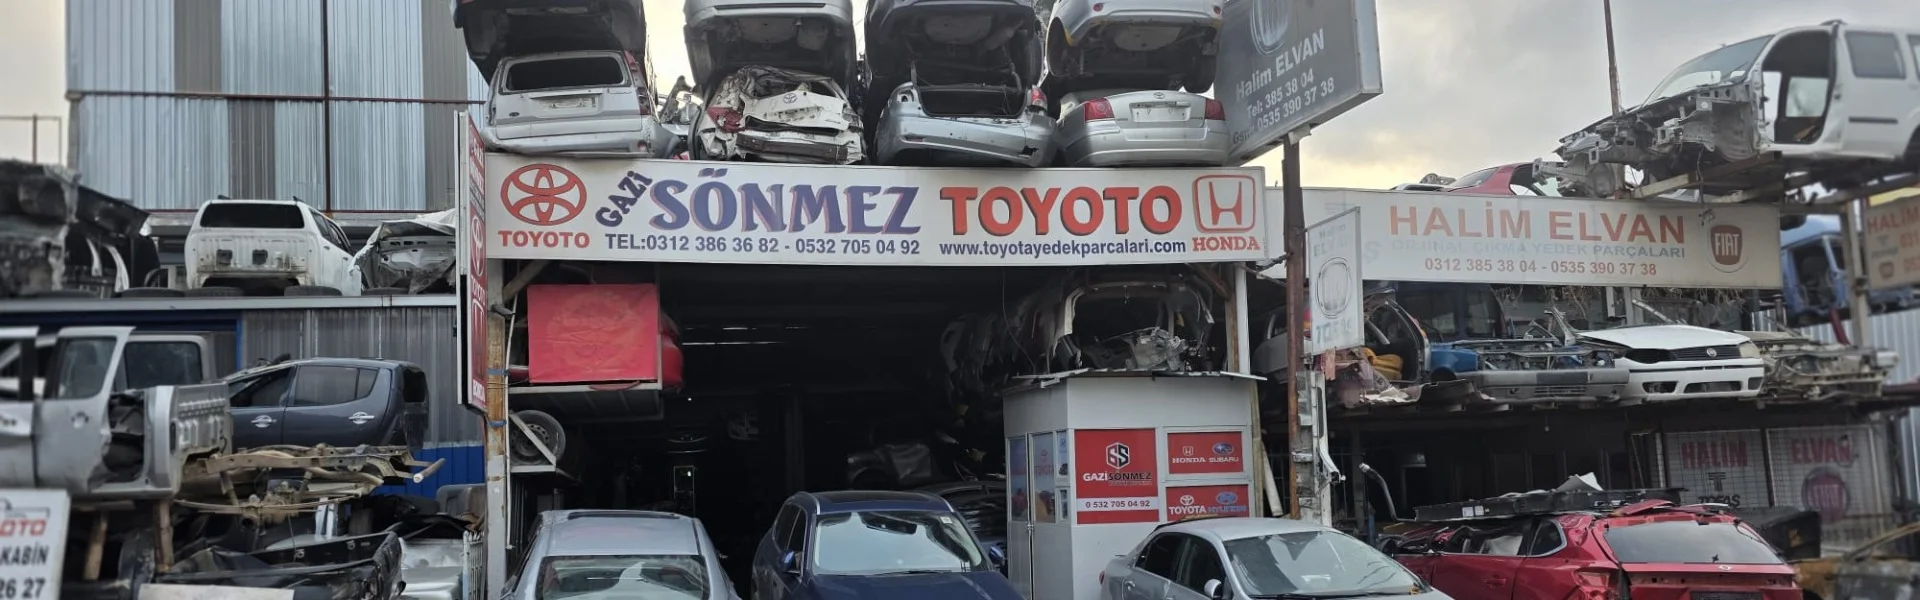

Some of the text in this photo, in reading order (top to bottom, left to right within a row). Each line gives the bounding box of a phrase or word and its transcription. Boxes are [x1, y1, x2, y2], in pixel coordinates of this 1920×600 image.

[1236, 28, 1325, 101] Halim ELVAN
[1265, 90, 1283, 109] 385
[1285, 79, 1298, 97] 38
[1300, 68, 1315, 88] 04
[1257, 107, 1281, 132] 0535
[1283, 95, 1301, 119] 390
[1304, 83, 1317, 106] 37
[1320, 77, 1335, 97] 38
[649, 167, 921, 235] SÖNMEZ
[939, 185, 1183, 237] TOYOTO
[1389, 201, 1532, 240] HALİM
[1548, 210, 1685, 244] ELVAN
[498, 230, 590, 249] TOYOTO
[605, 233, 690, 251] TEL:0312
[695, 236, 727, 252] 386
[732, 237, 754, 252] 36
[758, 238, 779, 253] 82
[795, 239, 836, 254] 0532
[841, 239, 871, 254] 705
[876, 240, 896, 254] 04
[900, 240, 921, 255] 92
[939, 238, 1186, 259] www.toyotayedekparcalari.com
[1192, 236, 1261, 252] HONDA
[1714, 232, 1741, 257] FIAT
[1532, 243, 1588, 256] YEDEK
[1592, 244, 1685, 259] PARÇALARI
[1425, 258, 1461, 271] 0312
[1466, 258, 1492, 272] 385
[1497, 260, 1514, 272] 38
[1519, 260, 1537, 273] 04
[1551, 260, 1585, 274] 0535
[1590, 262, 1615, 275] 390
[1620, 262, 1635, 275] 37
[1641, 262, 1657, 276] 38
[1085, 499, 1151, 509] 0 532 705 04 92
[1168, 506, 1207, 515] TOYOTA
[21, 577, 47, 600] 27
